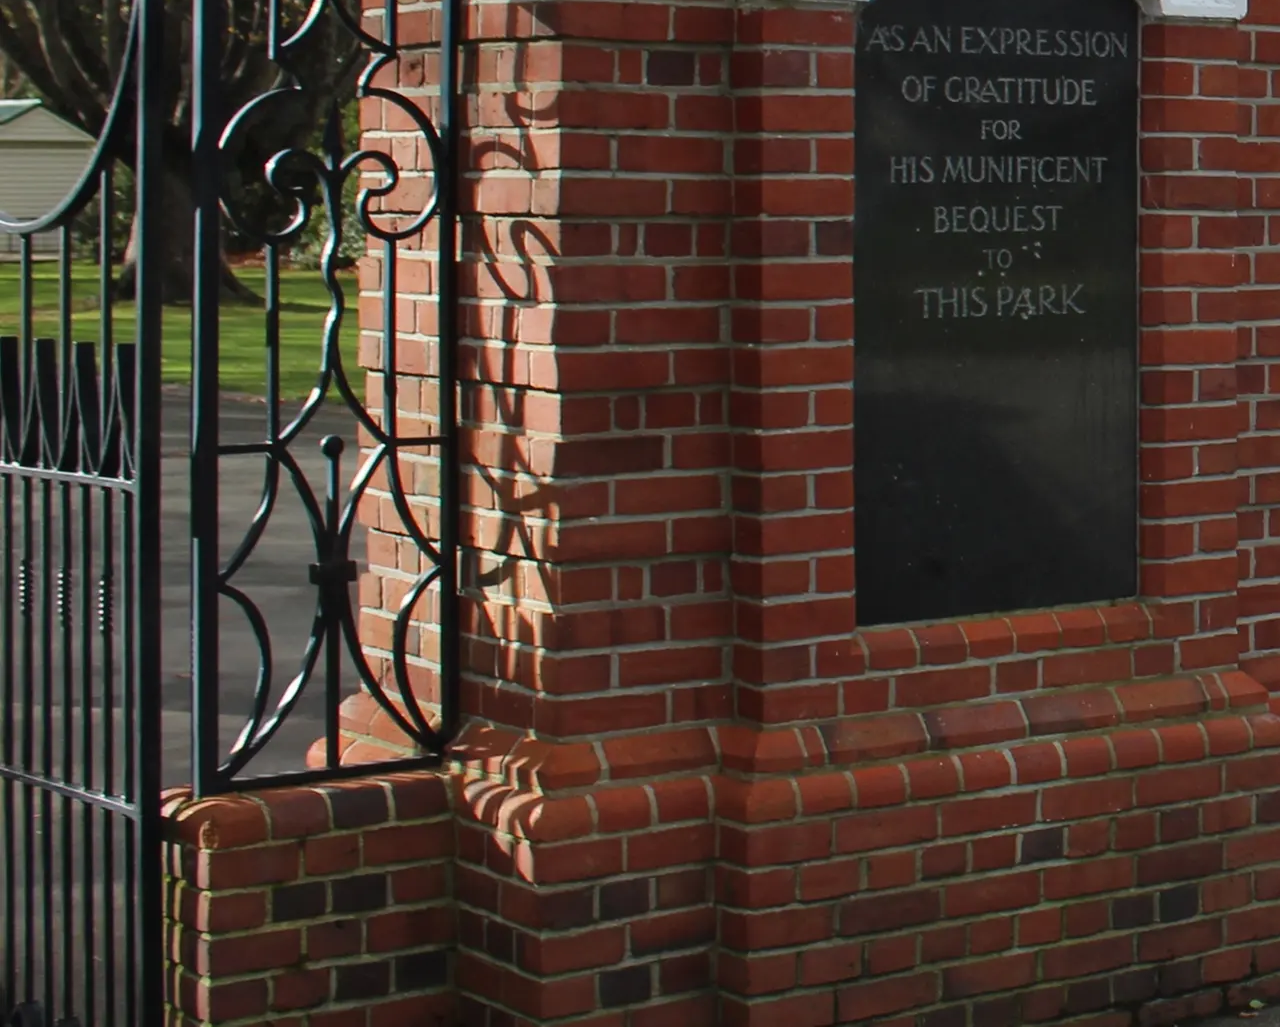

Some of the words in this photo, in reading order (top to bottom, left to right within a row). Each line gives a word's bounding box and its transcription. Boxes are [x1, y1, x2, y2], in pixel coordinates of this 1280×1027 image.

[865, 26, 905, 52] AS
[909, 25, 950, 54] AN
[961, 26, 1128, 58] EXPRESSION
[902, 76, 937, 102] OF
[945, 76, 1097, 106] GRATITUDE
[980, 120, 1022, 140] FOR
[891, 156, 934, 183] HIS
[942, 156, 1107, 183] MUNIFICENT
[934, 206, 1063, 233] BEQUEST
[982, 249, 1012, 269] TO
[914, 287, 987, 318] THIS
[997, 284, 1086, 316] PARK
